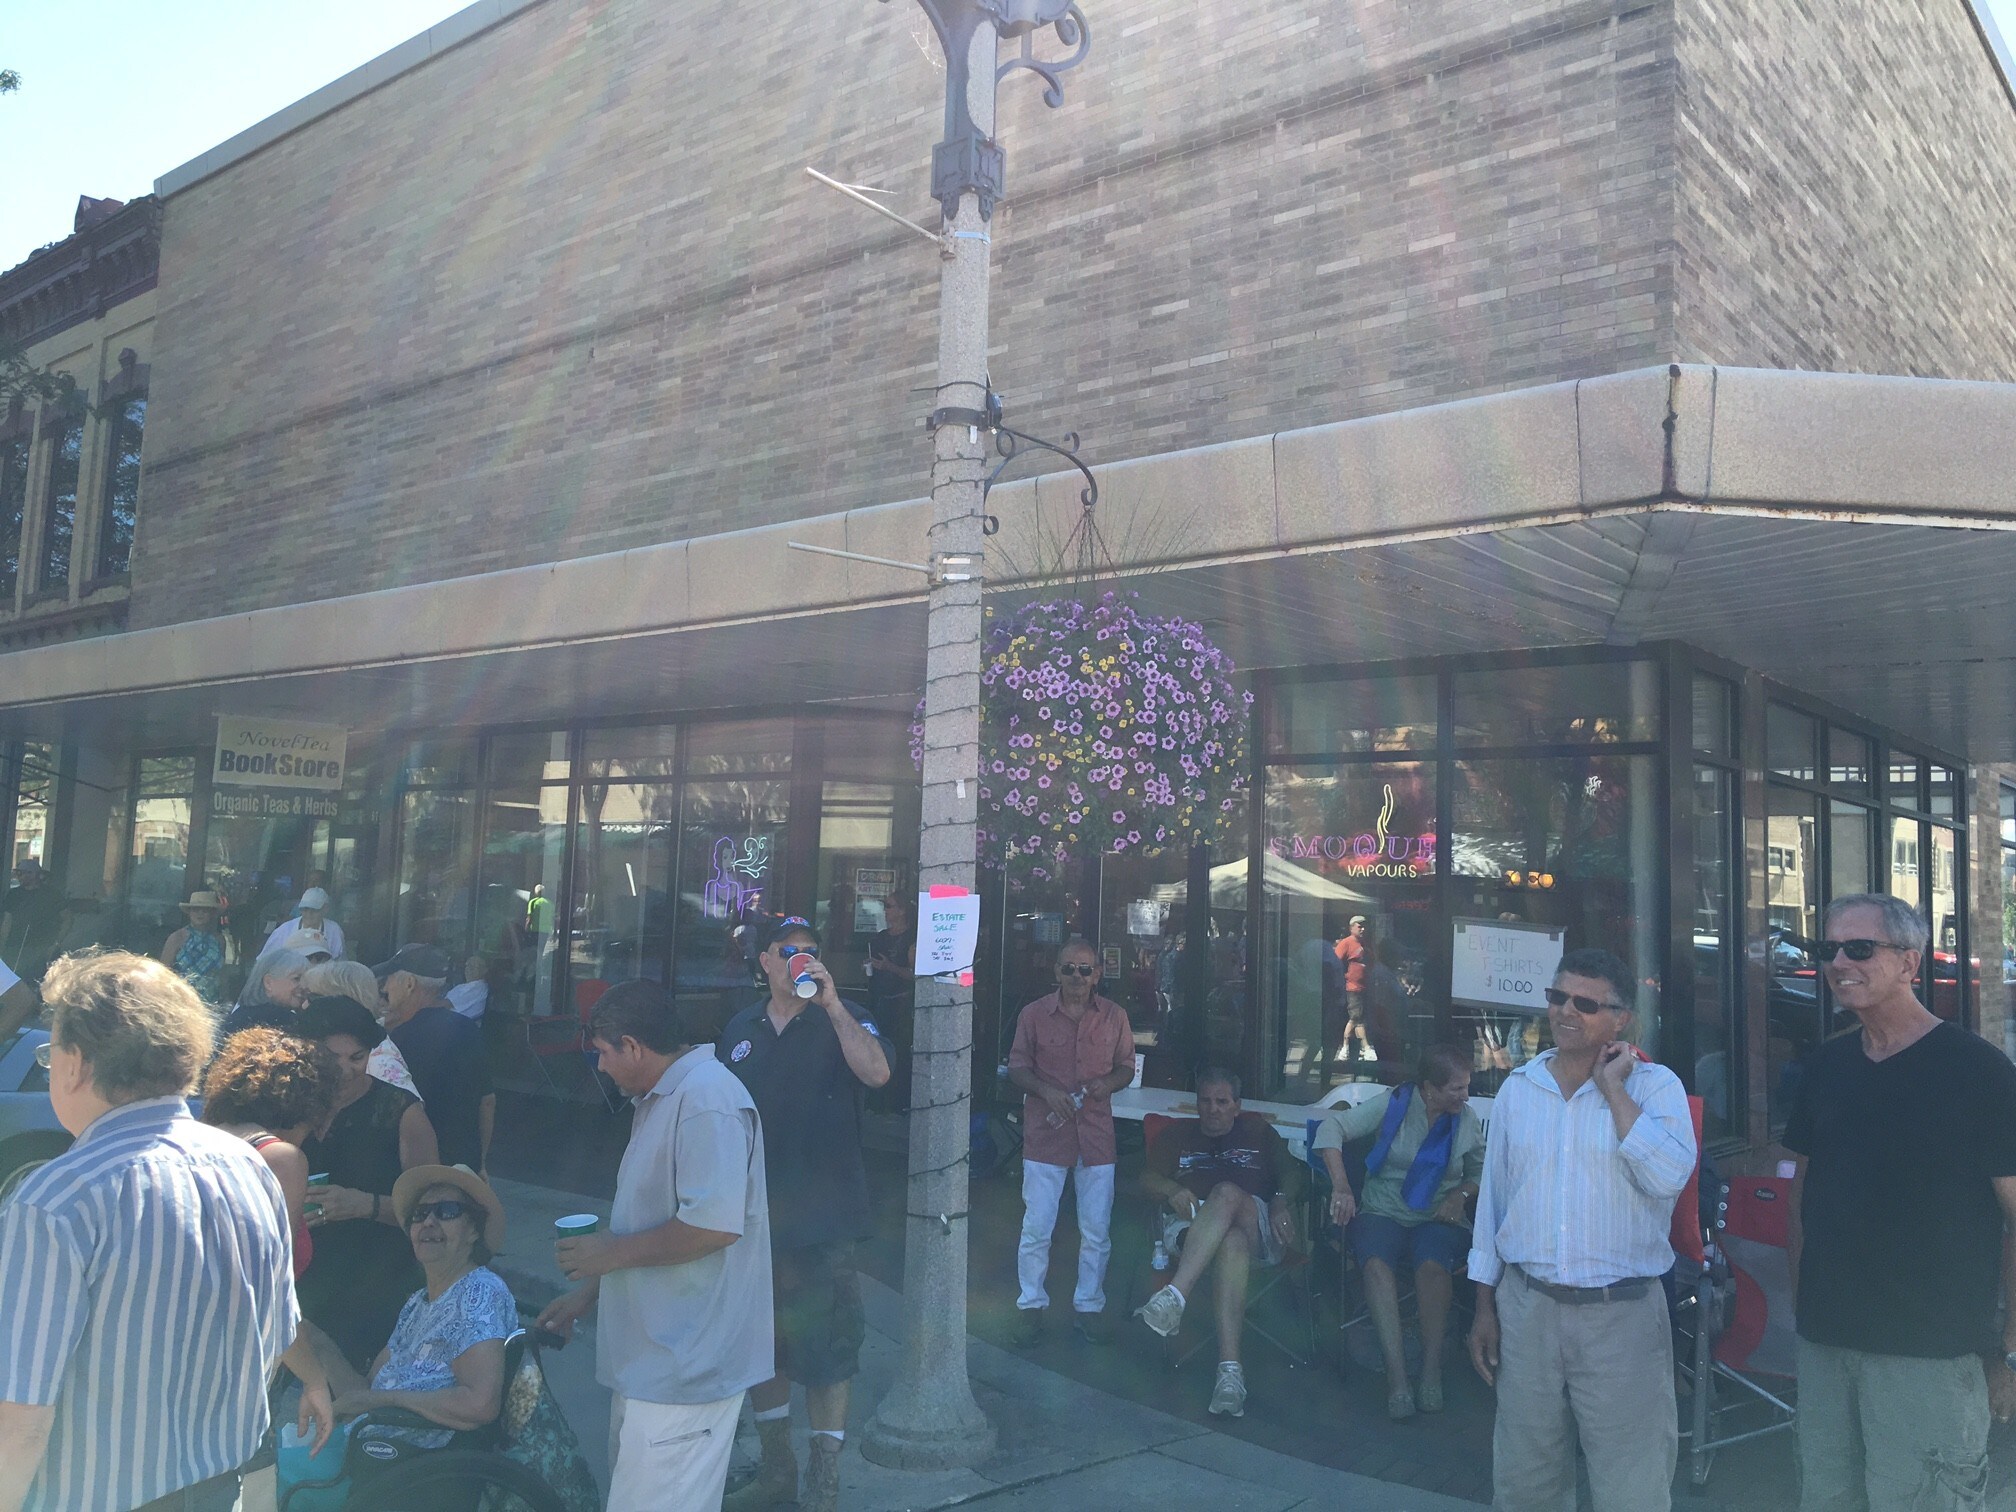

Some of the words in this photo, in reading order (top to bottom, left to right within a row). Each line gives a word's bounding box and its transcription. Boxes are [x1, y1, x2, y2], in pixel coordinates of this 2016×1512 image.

[219, 750, 340, 778] BookStore
[213, 791, 259, 814] Organic
[263, 794, 290, 814] Teas
[293, 796, 302, 815] &
[305, 796, 338, 816] Herbs
[1347, 863, 1417, 878] VAPOURS
[932, 912, 966, 921] ESTATE
[934, 923, 957, 932] SALE
[1468, 934, 1520, 953] EVENT
